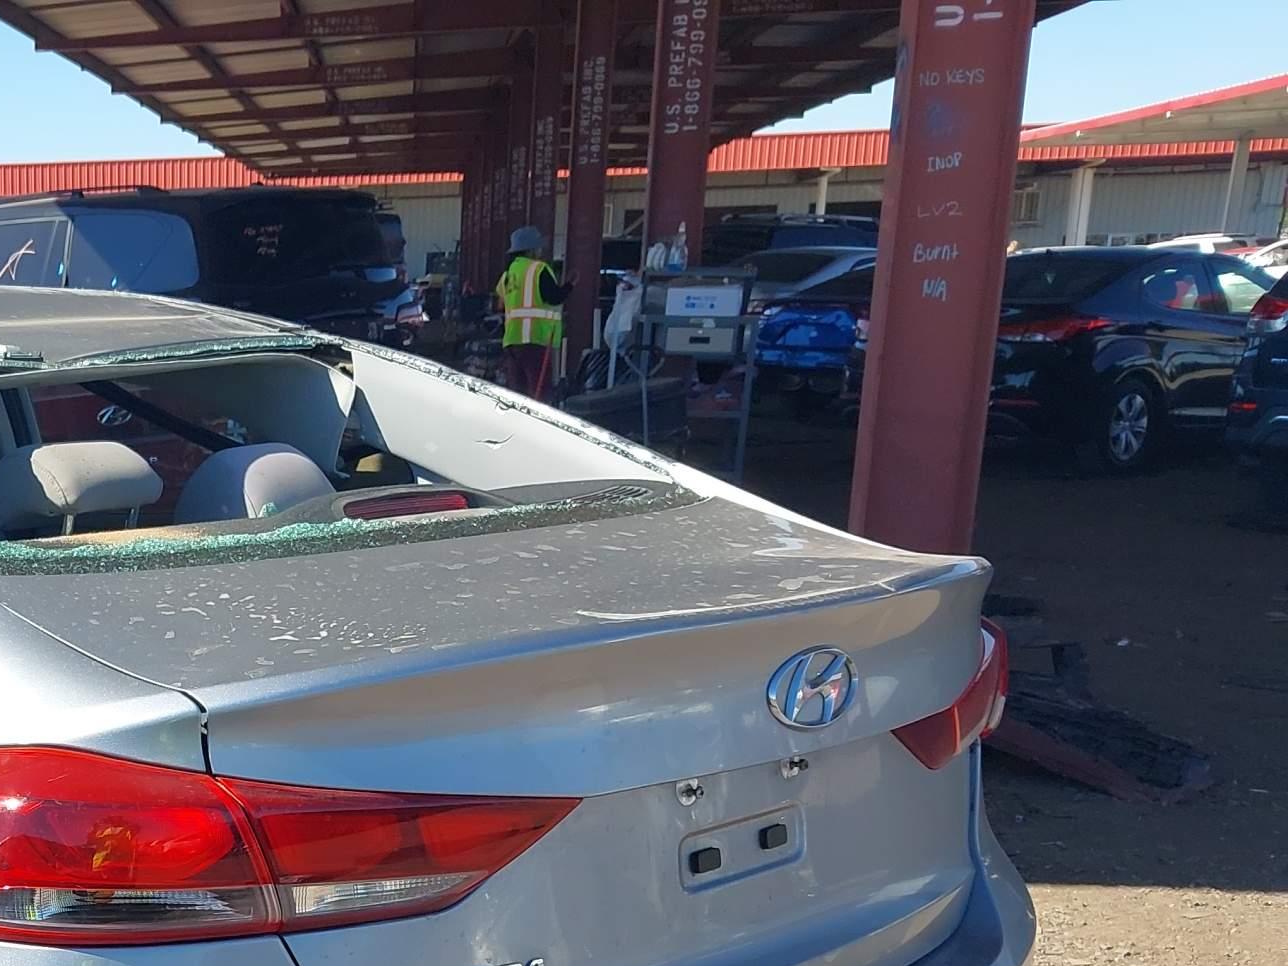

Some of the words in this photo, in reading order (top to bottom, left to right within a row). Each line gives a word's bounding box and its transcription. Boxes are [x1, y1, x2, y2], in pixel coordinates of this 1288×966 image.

[668, 14, 688, 88] PREFAB
[947, 68, 985, 84] KEYS
[928, 152, 962, 172] INOP
